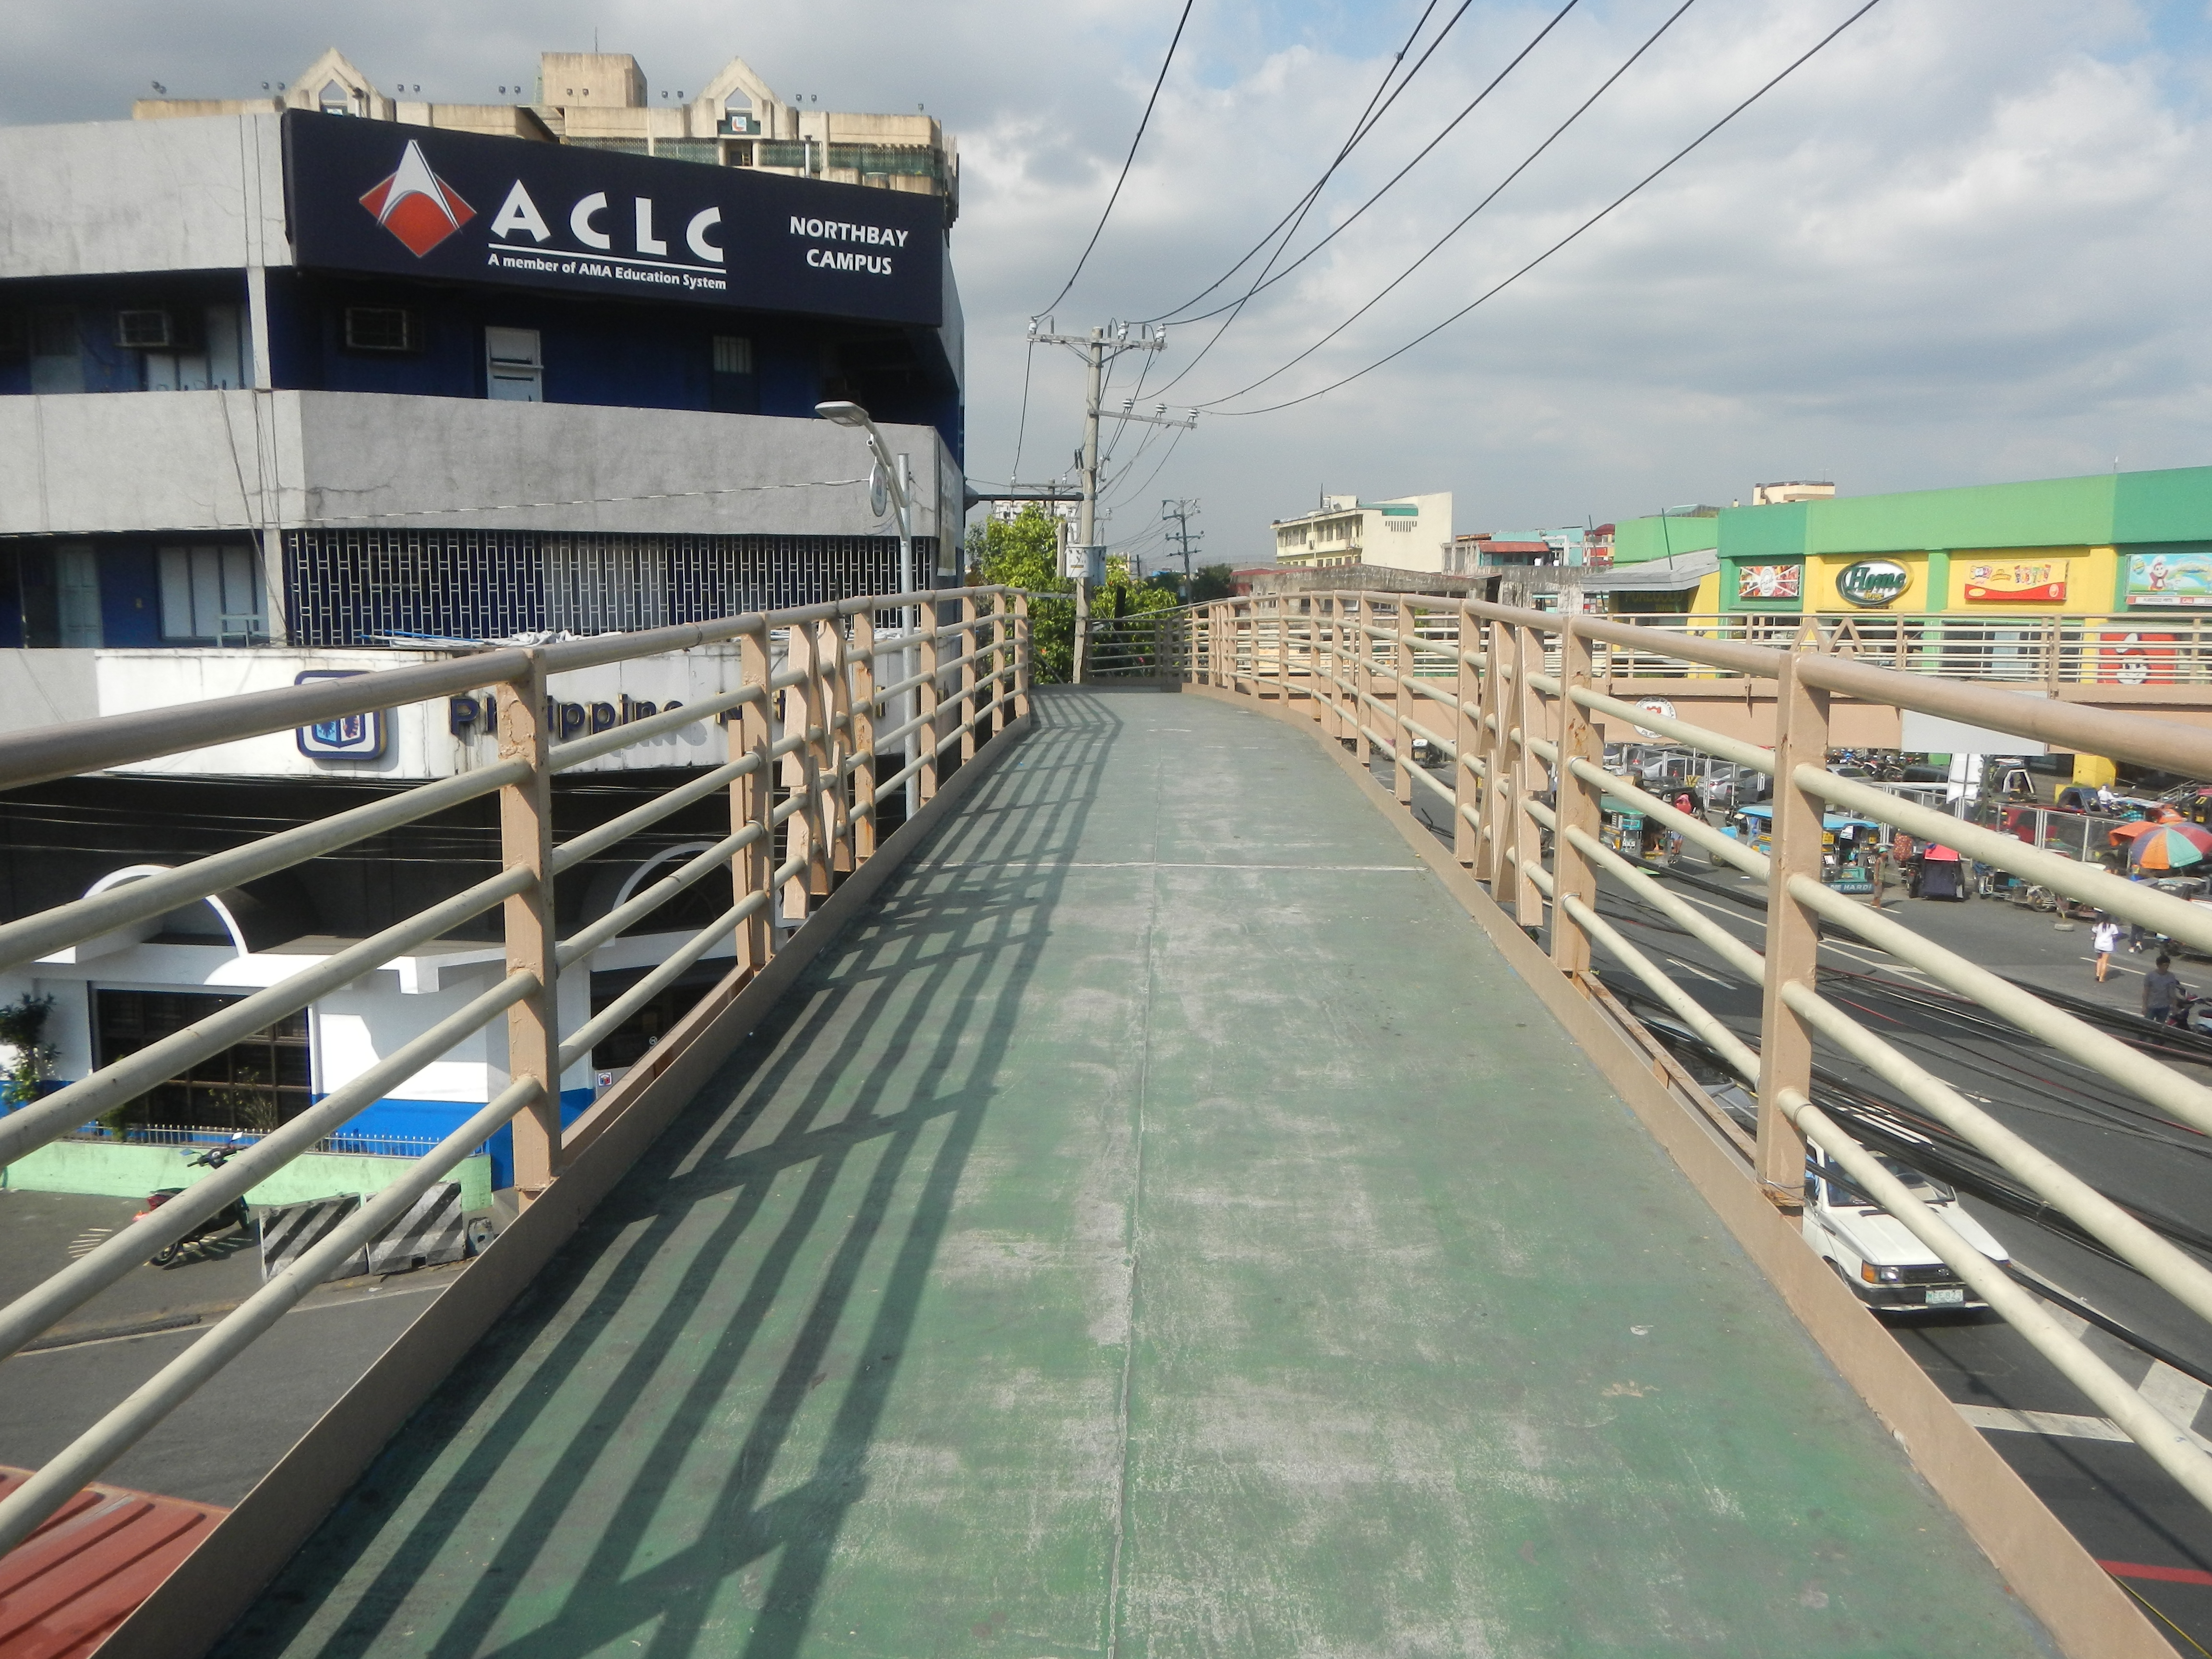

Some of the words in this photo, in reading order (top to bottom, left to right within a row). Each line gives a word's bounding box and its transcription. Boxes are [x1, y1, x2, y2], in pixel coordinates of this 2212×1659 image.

[490, 179, 724, 263] ACLC
[790, 216, 909, 247] NORTHBAY
[488, 253, 499, 266] A
[503, 256, 558, 272] member
[562, 261, 576, 274] of
[578, 263, 613, 277] AMA
[615, 267, 680, 284] Education
[683, 274, 727, 289] System
[806, 249, 892, 275] CAMPUS
